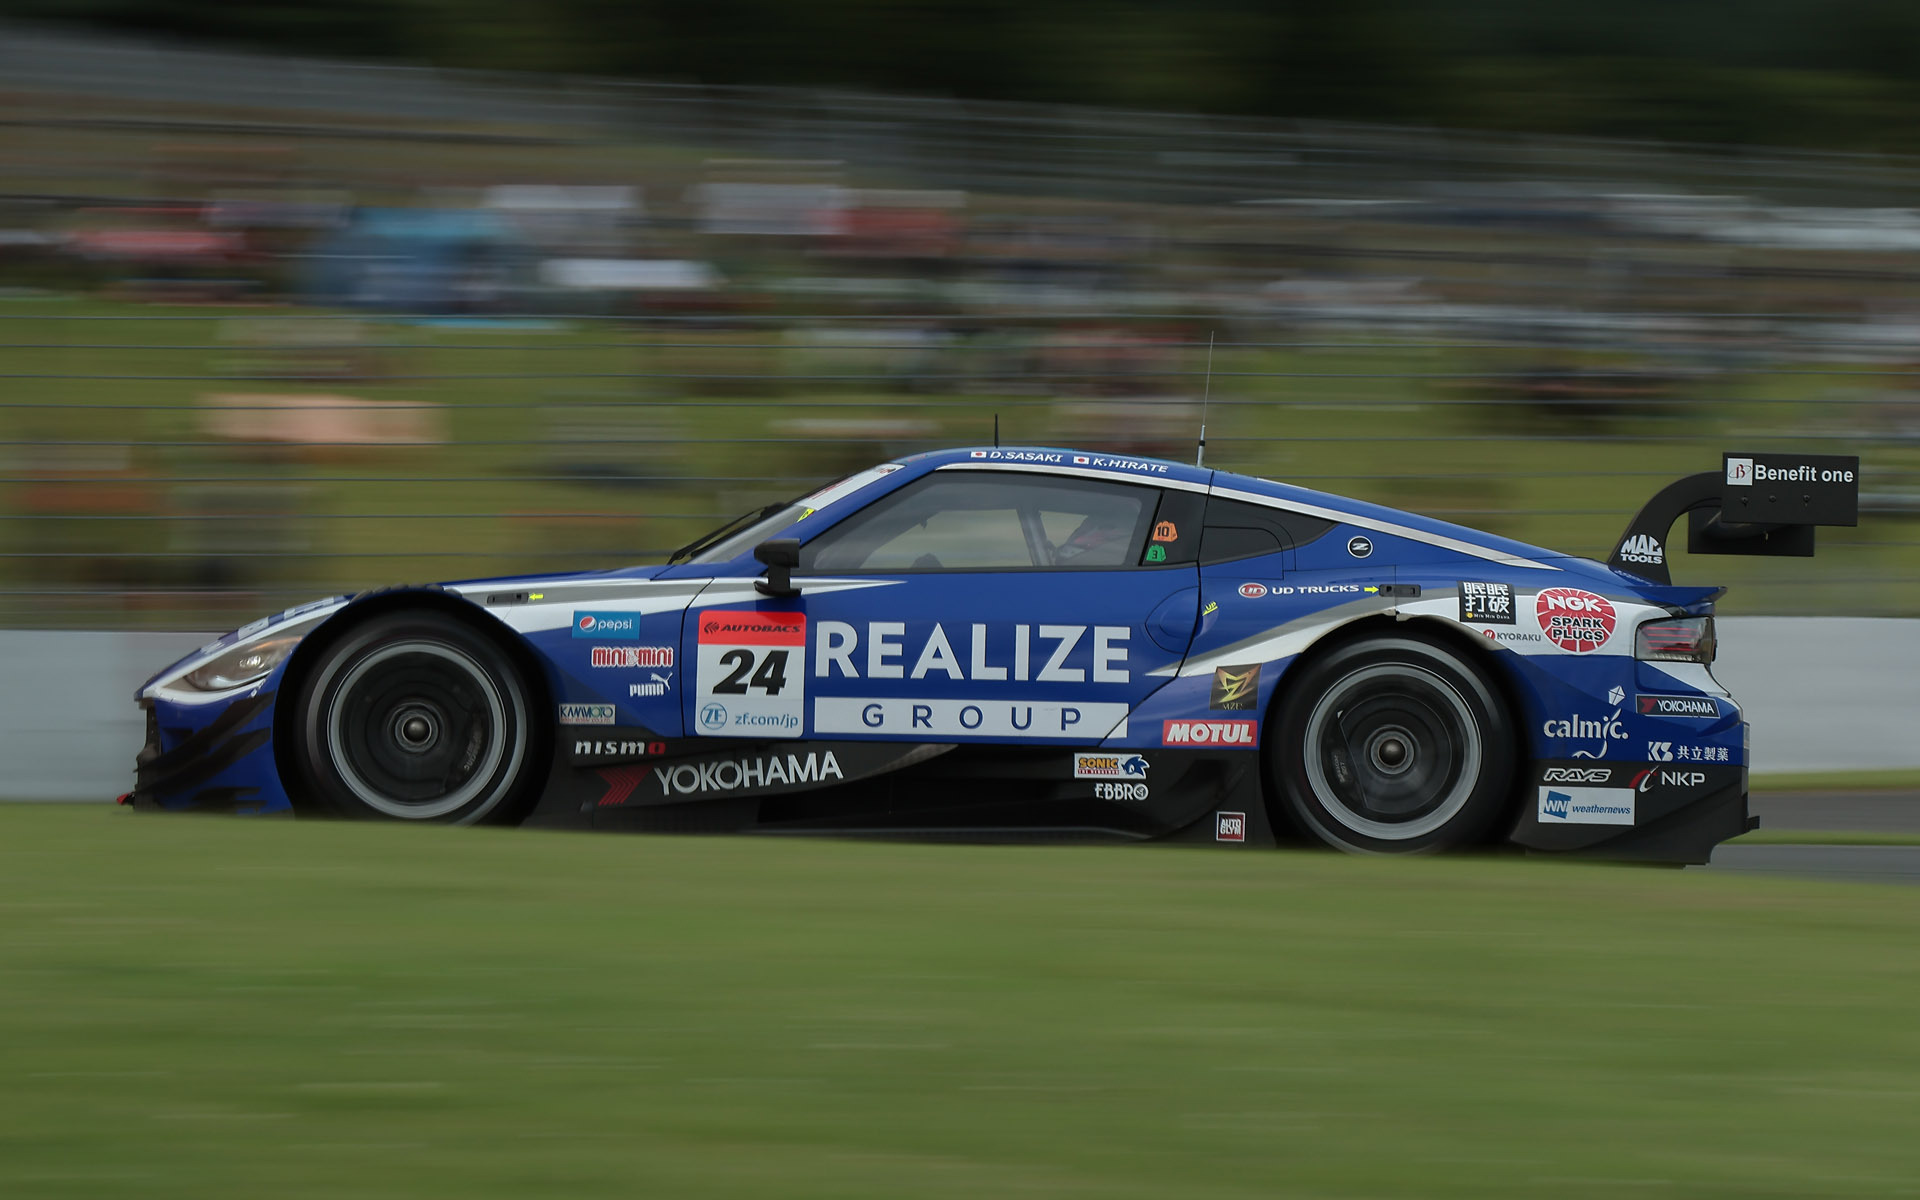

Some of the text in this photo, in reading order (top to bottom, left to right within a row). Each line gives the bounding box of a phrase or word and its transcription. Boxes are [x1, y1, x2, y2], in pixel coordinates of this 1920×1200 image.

[990, 451, 1063, 463] D.SASAKI
[1093, 458, 1169, 473] K.HIRATE
[1755, 464, 1854, 482] Benefit one
[1157, 526, 1170, 537] 10
[1621, 534, 1662, 555] MAC
[1151, 550, 1159, 559] 3
[1621, 554, 1662, 564] TOOLS
[1272, 584, 1360, 595] UD TRUCKS
[1463, 582, 1509, 596] 眠眠
[1464, 594, 1510, 614] 打破
[1546, 596, 1602, 612] NGK
[598, 619, 632, 631] pepsi
[721, 624, 801, 633] AUTOBACS
[1552, 617, 1603, 629] SPARK
[1497, 632, 1541, 642] KYORAKU
[1553, 628, 1604, 641] PLUGS
[815, 621, 1131, 683] REALIZE
[712, 649, 789, 696] 24
[629, 683, 664, 697] PUMA
[1657, 700, 1715, 714] YOKOHAMA
[735, 712, 799, 728] zf.com/jp
[862, 703, 1081, 731] GROUP
[1166, 723, 1253, 743] MOTUL
[575, 740, 666, 755] nismo
[1677, 745, 1729, 761] 共立製薬
[1079, 757, 1119, 769] SONIC
[654, 750, 843, 796] YOKOHAMA
[1544, 768, 1611, 782] RAYS
[1661, 771, 1706, 787] NKP
[1095, 783, 1149, 800] EBBRO
[1572, 804, 1631, 815] weathernews
[1221, 818, 1241, 827] AUTO
